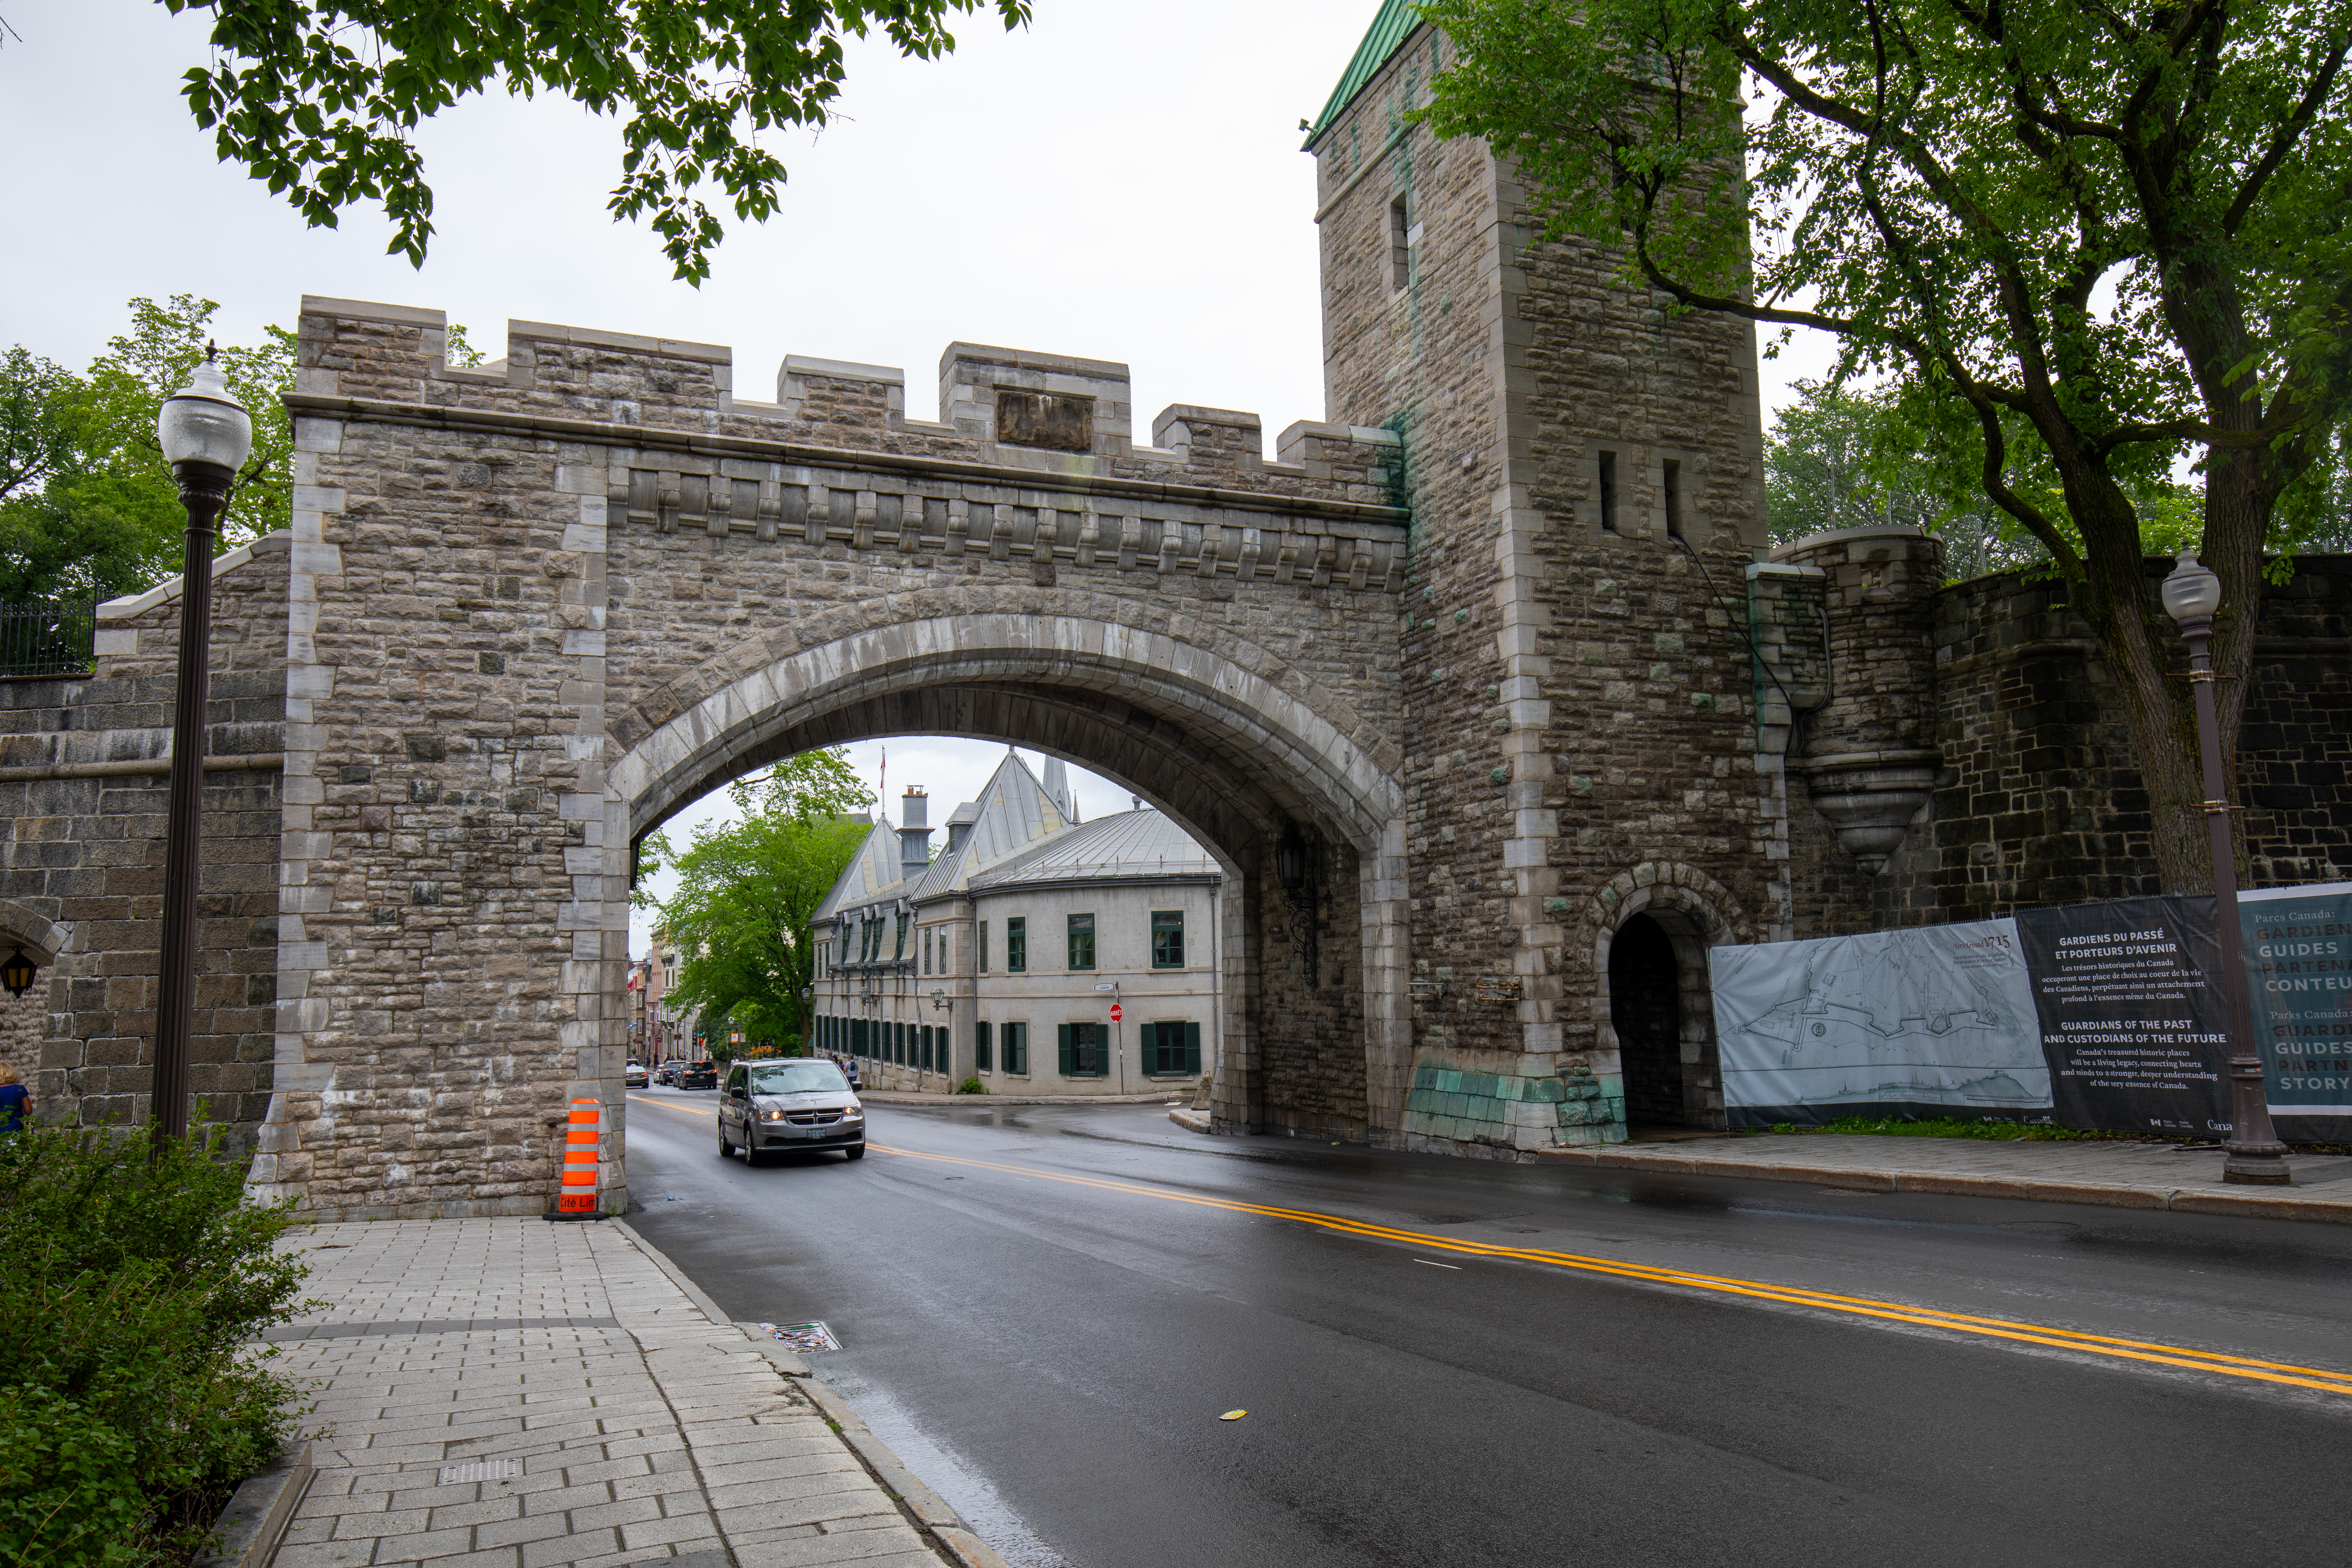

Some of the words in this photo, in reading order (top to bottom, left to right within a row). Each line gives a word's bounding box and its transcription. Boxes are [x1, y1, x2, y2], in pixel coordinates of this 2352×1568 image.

[2289, 910, 2335, 920] Canada:
[2060, 934, 2110, 945] GARDIENS
[2113, 933, 2127, 941] DU
[2130, 927, 2164, 940] PASSÉ
[1983, 935, 2010, 949] 1715
[2055, 951, 2067, 959] ET
[2069, 946, 2123, 958] PORTEURS
[2126, 944, 2177, 954] D'AVENIR
[2259, 942, 2338, 957] GUIDES
[2098, 961, 2134, 969] historiques
[2092, 973, 2110, 982] place
[2092, 983, 2128, 992] perpétuant
[2061, 995, 2087, 1004] profond
[2270, 1011, 2301, 1019] Parks
[2061, 1020, 2122, 1030] GUARDIANS
[2125, 1020, 2136, 1028] OF
[2139, 1020, 2160, 1029] THE
[2163, 1020, 2192, 1028] PAST
[2044, 1035, 2065, 1043] AND
[2067, 1034, 2133, 1043] CUSTODIANS
[2136, 1034, 2148, 1043] OF
[2151, 1034, 2174, 1043] THE
[2177, 1034, 2226, 1043] FUTURE
[2275, 1041, 2352, 1054] GUIDES
[2167, 1049, 2190, 1058] places
[2097, 1059, 2116, 1067] living
[2116, 1059, 2139, 1068] legacy,
[2140, 1060, 2178, 1069] connecting
[2140, 1070, 2161, 1079] deeper
[2163, 1071, 2218, 1081] understanding
[2280, 1077, 2350, 1089] STORY
[2024, 1116, 2053, 1124] Canada
[561, 1197, 576, 1208] Cité
